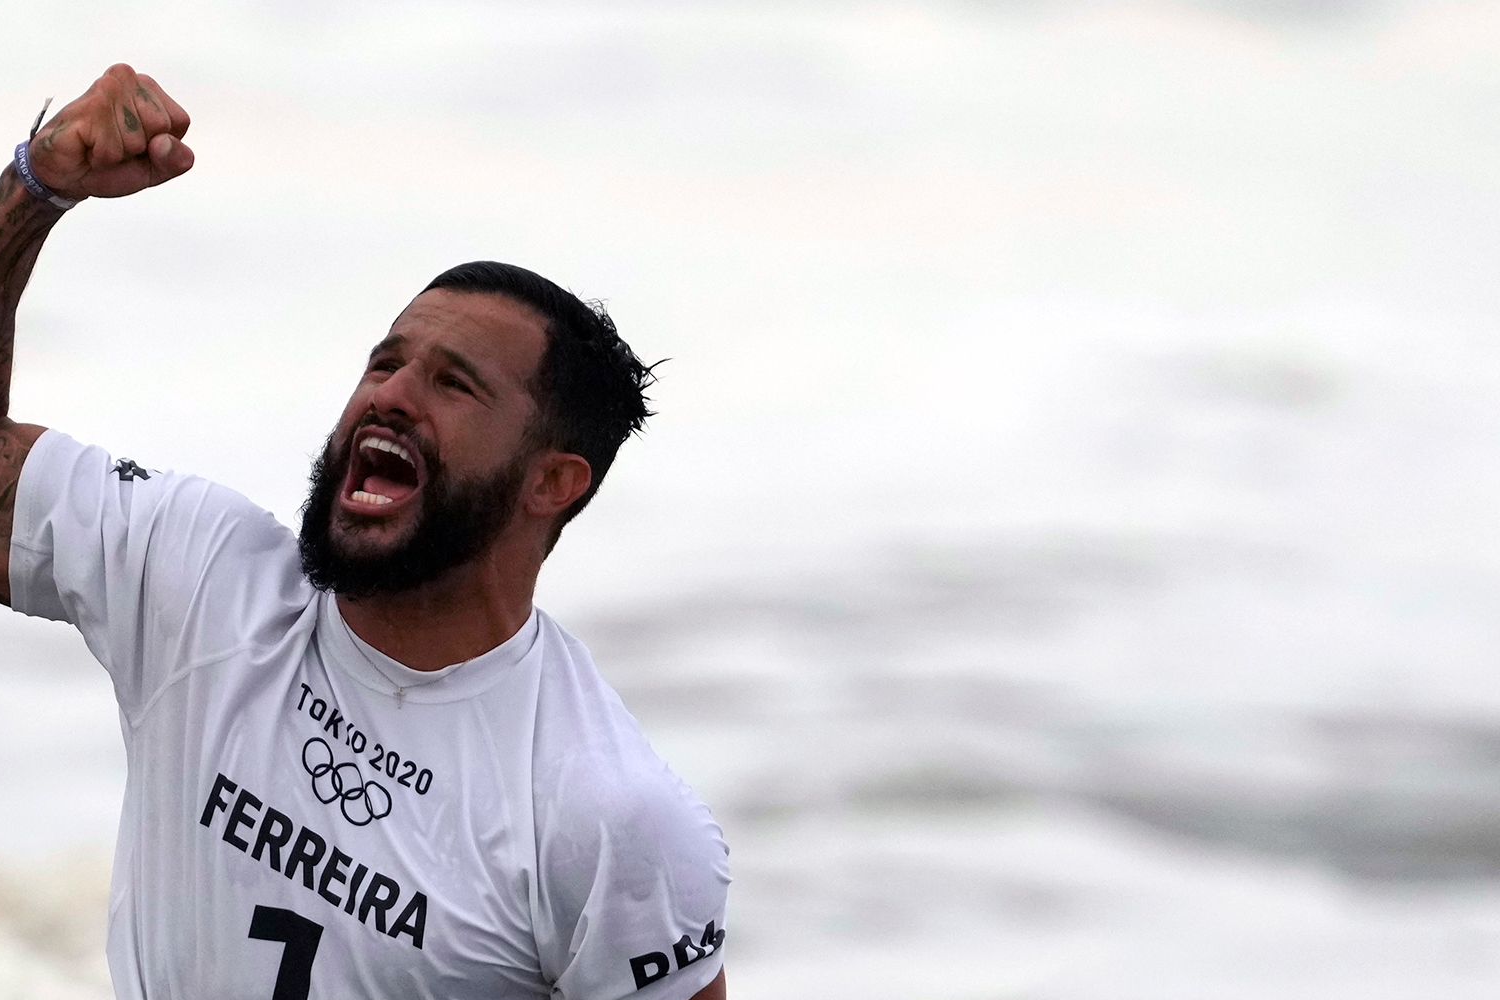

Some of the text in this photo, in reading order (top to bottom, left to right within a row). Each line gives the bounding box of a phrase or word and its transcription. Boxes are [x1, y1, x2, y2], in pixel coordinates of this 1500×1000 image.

[18, 147, 29, 175] TOKYO
[297, 682, 434, 796] TOKYO 2020
[200, 772, 428, 951] FERREIRA
